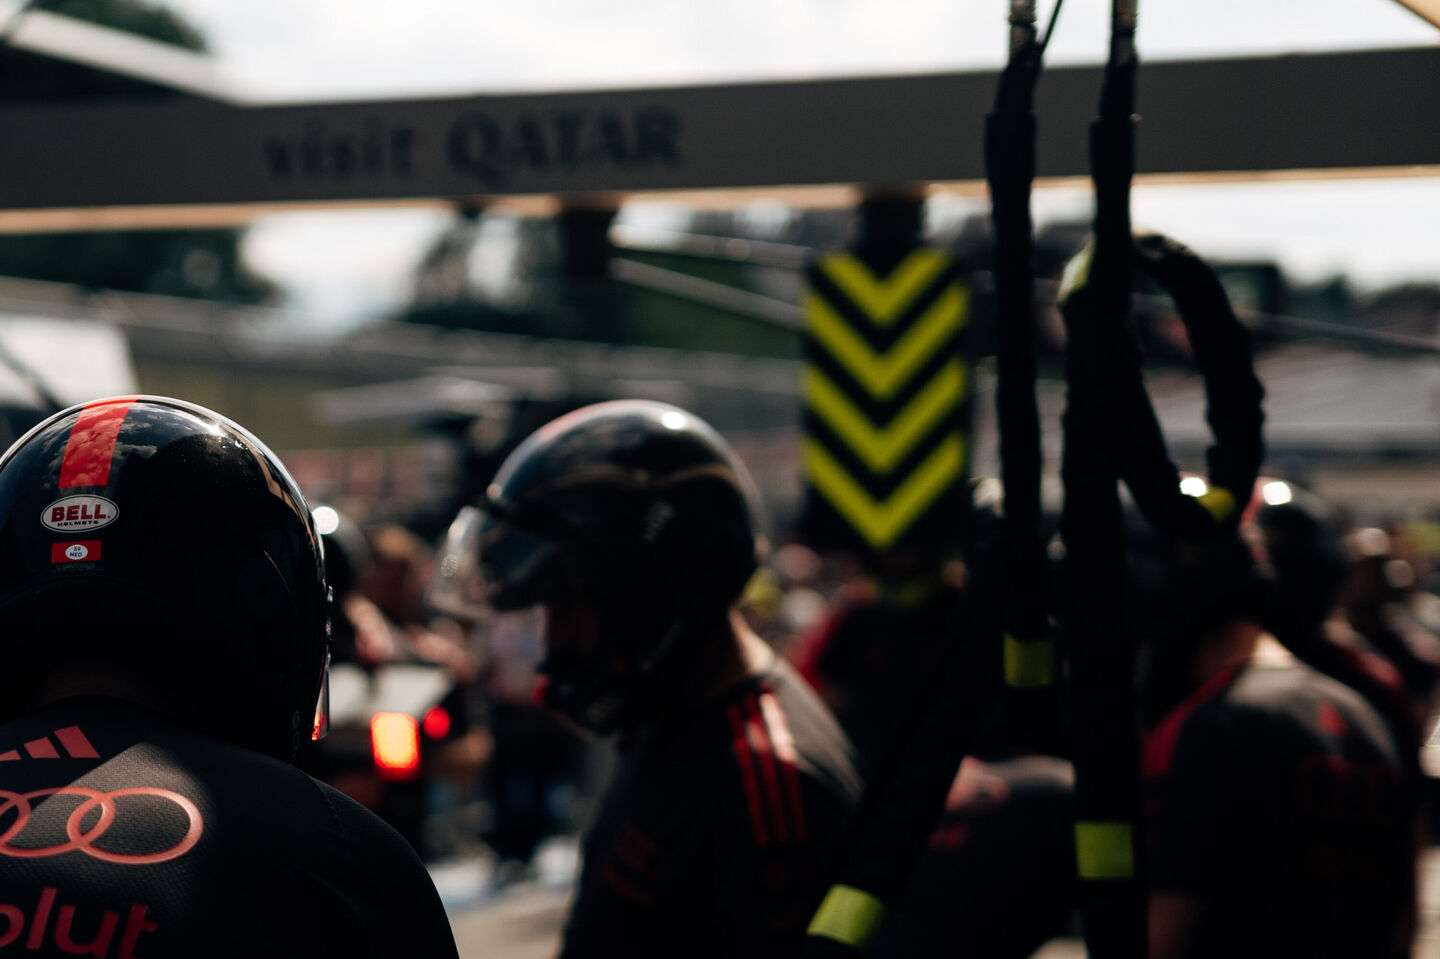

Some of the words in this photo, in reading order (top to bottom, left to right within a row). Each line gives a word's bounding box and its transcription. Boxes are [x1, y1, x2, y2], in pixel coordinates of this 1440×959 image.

[264, 116, 414, 181] visit
[446, 105, 684, 188] QATAR
[51, 504, 107, 522] BELL
